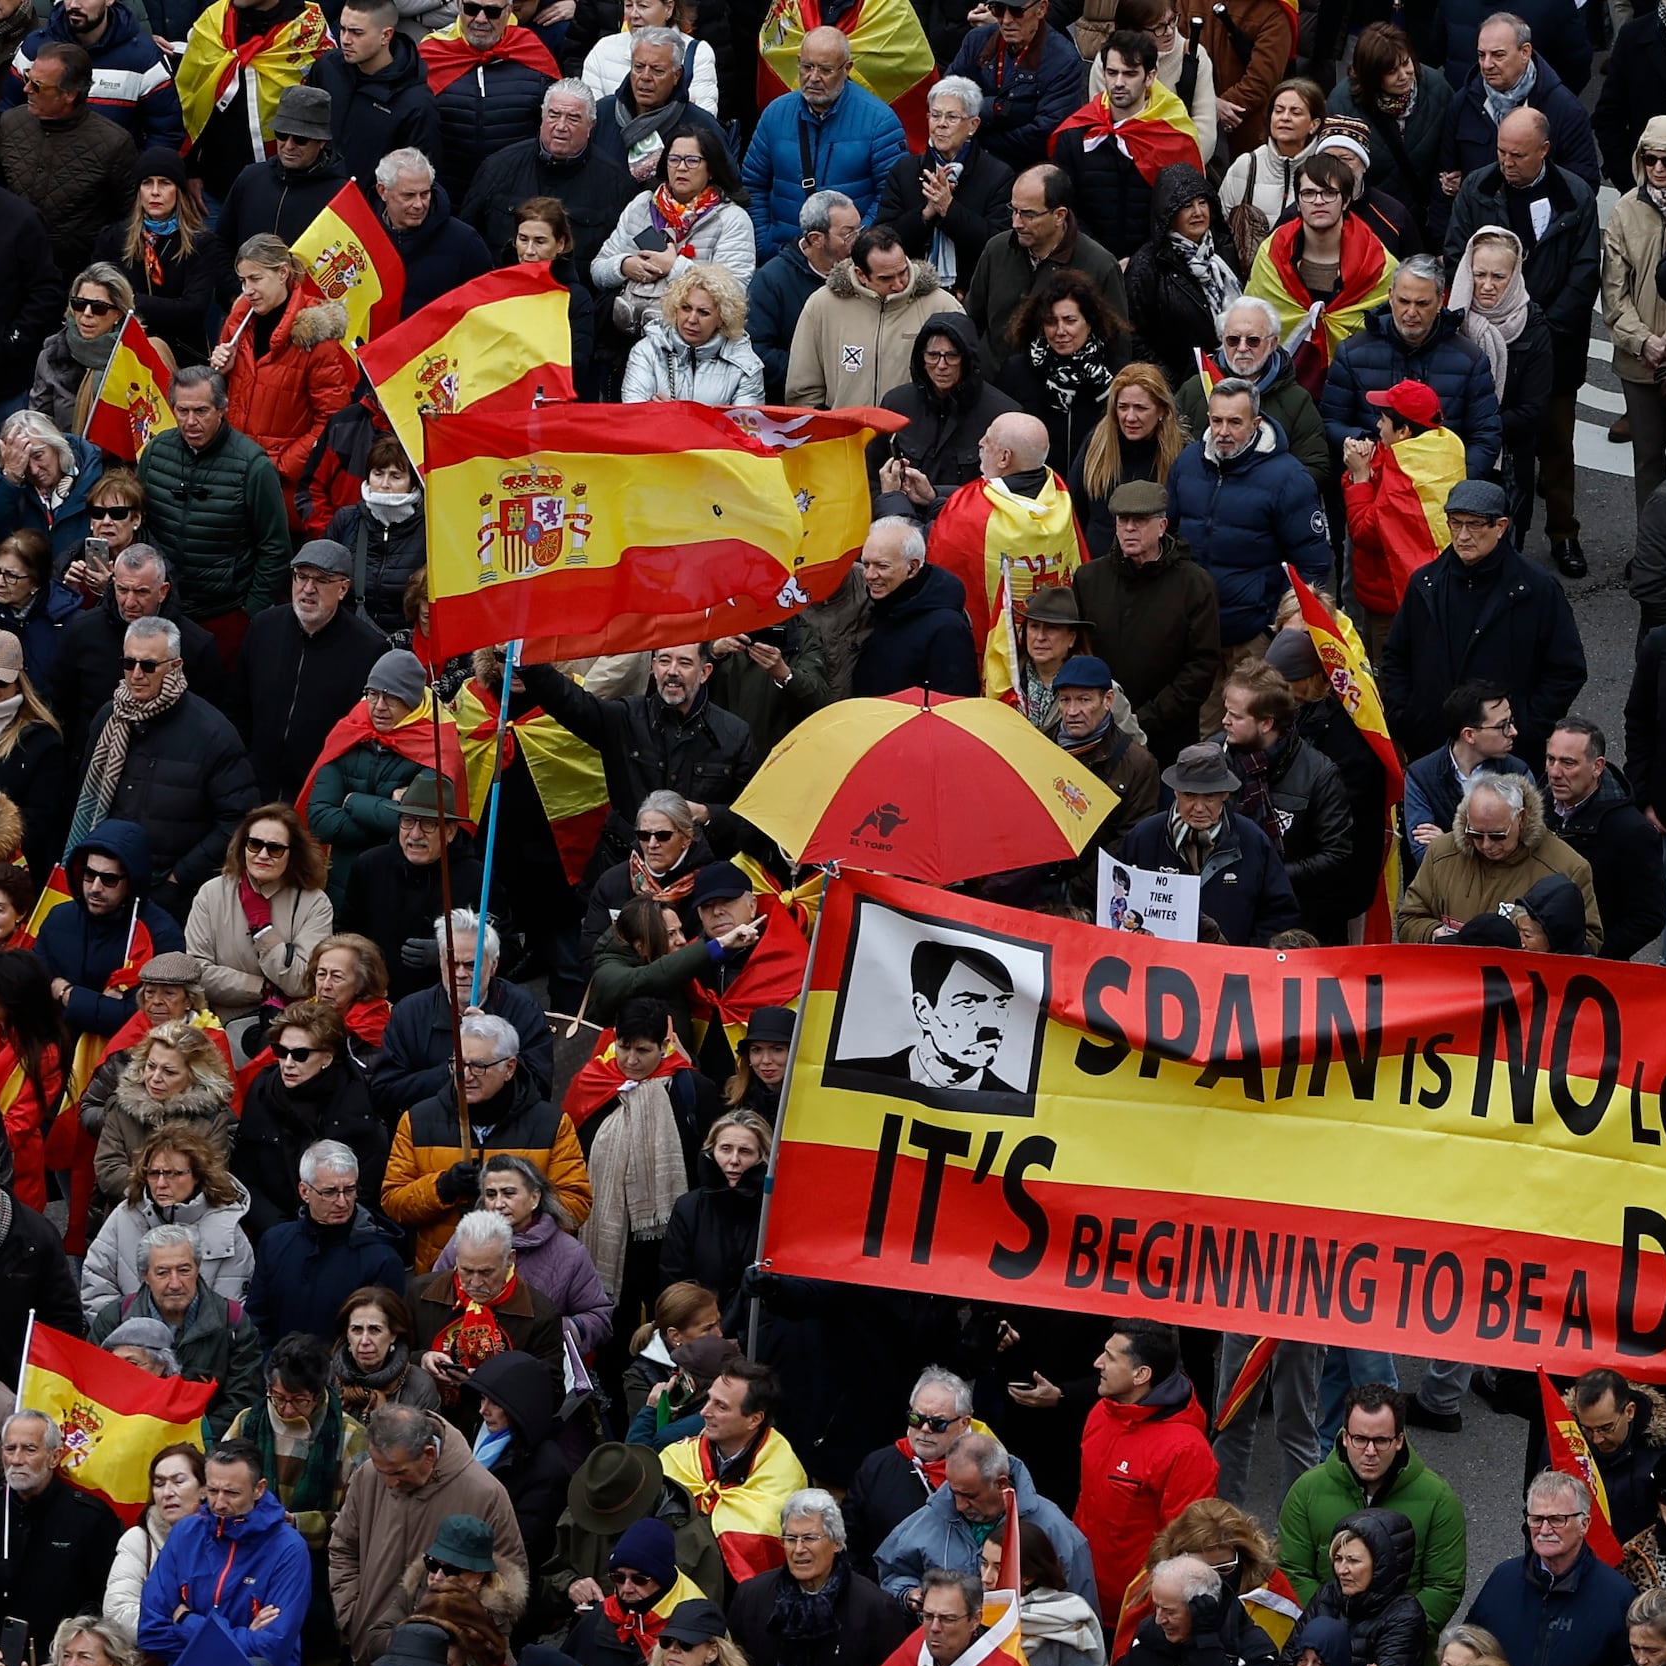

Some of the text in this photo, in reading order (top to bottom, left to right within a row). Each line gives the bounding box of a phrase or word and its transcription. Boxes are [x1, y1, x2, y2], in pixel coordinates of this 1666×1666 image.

[1155, 876, 1168, 887] NO
[1149, 891, 1174, 904] TIENE
[1143, 905, 1178, 922] LÍMITES
[1075, 957, 1383, 1105] SPAIN
[1399, 1032, 1454, 1110] IS
[1470, 965, 1622, 1136] NO
[1066, 1214, 1379, 1324] BEGINNING
[1393, 1247, 1464, 1334] TO
[1477, 1257, 1547, 1344] BE
[1557, 1269, 1592, 1350] A
